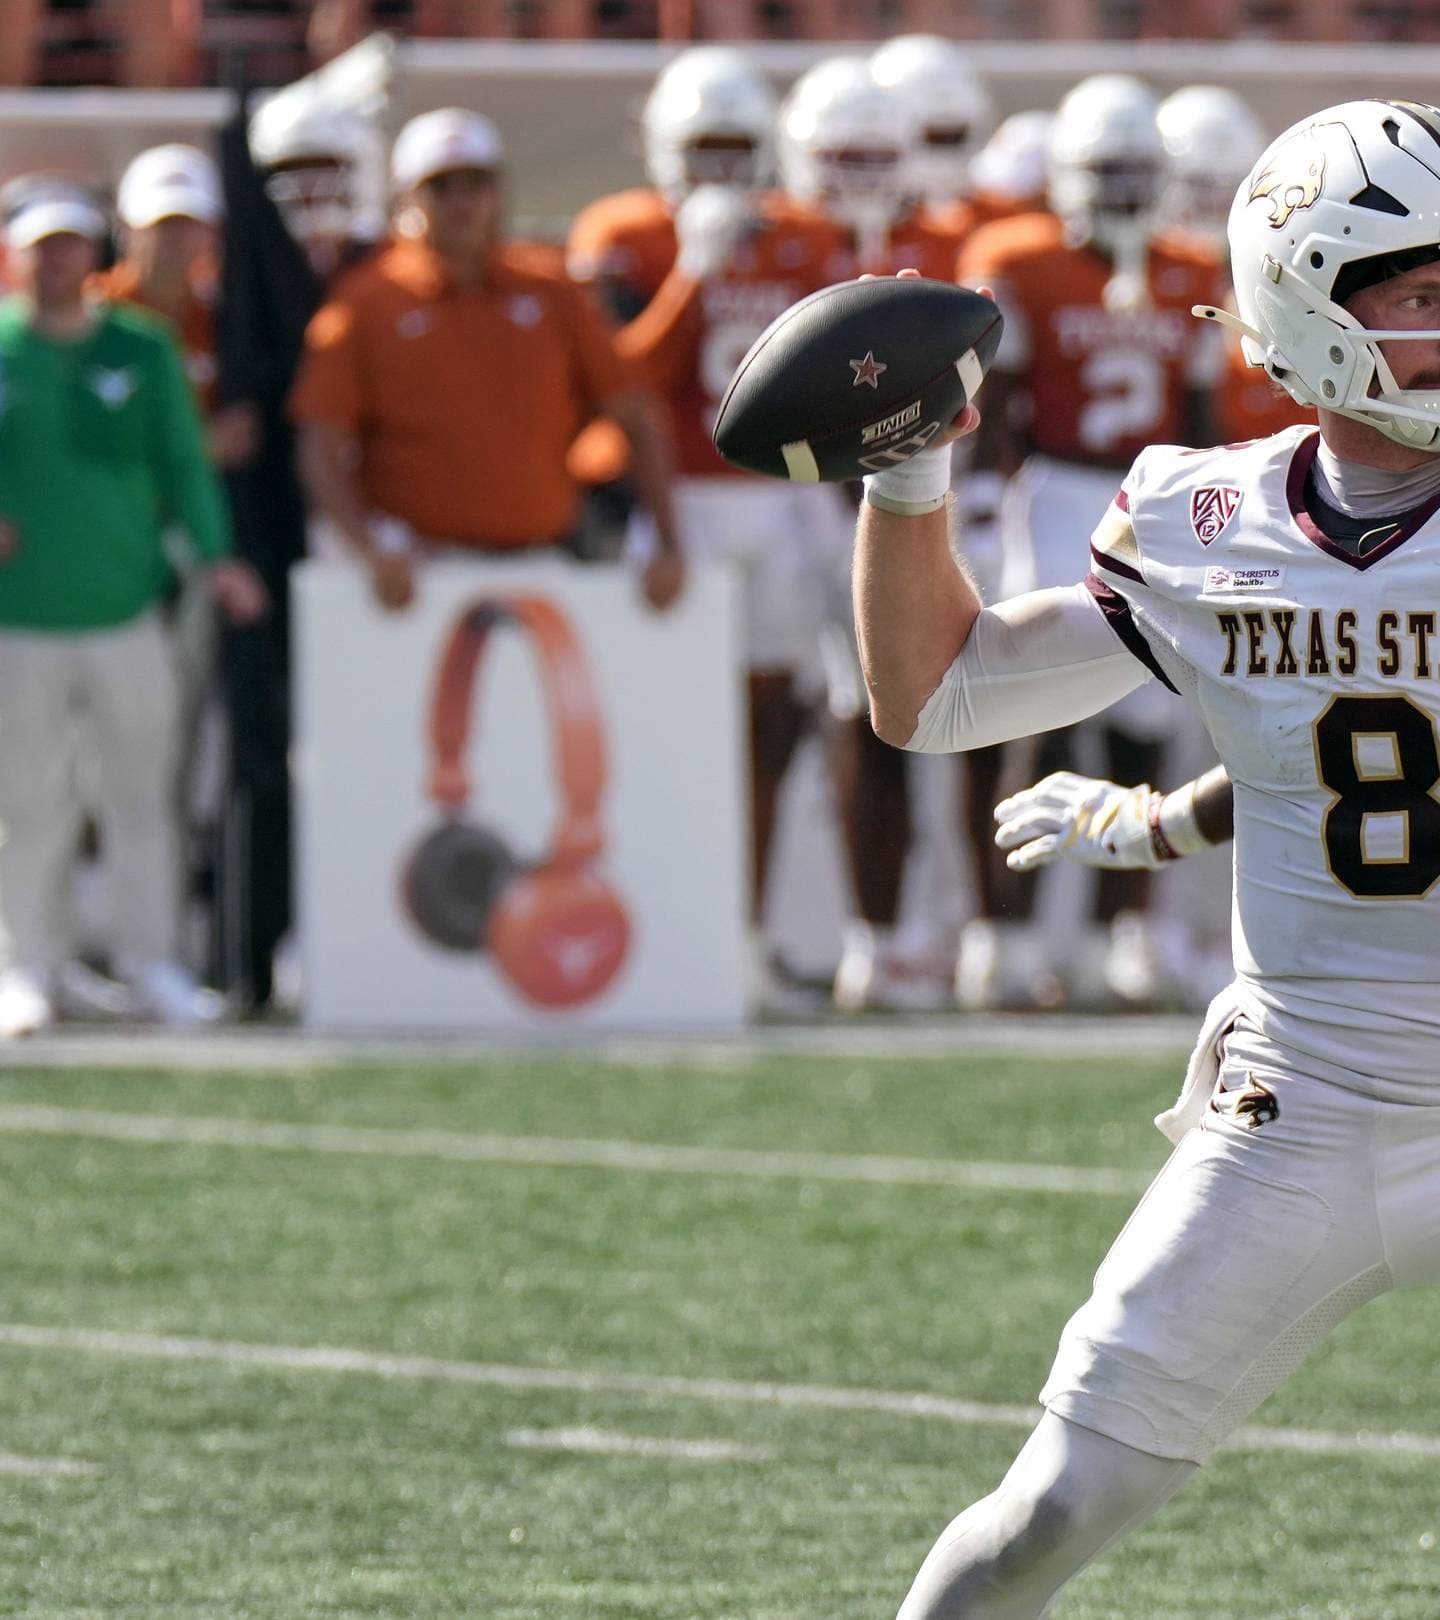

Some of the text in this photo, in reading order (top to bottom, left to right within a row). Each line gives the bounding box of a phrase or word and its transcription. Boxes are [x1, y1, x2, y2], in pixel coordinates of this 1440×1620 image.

[1192, 487, 1241, 521] PAC
[1202, 524, 1216, 537] 12
[1234, 569, 1280, 579] CHRISTUS
[1214, 608, 1360, 679] TEXAS
